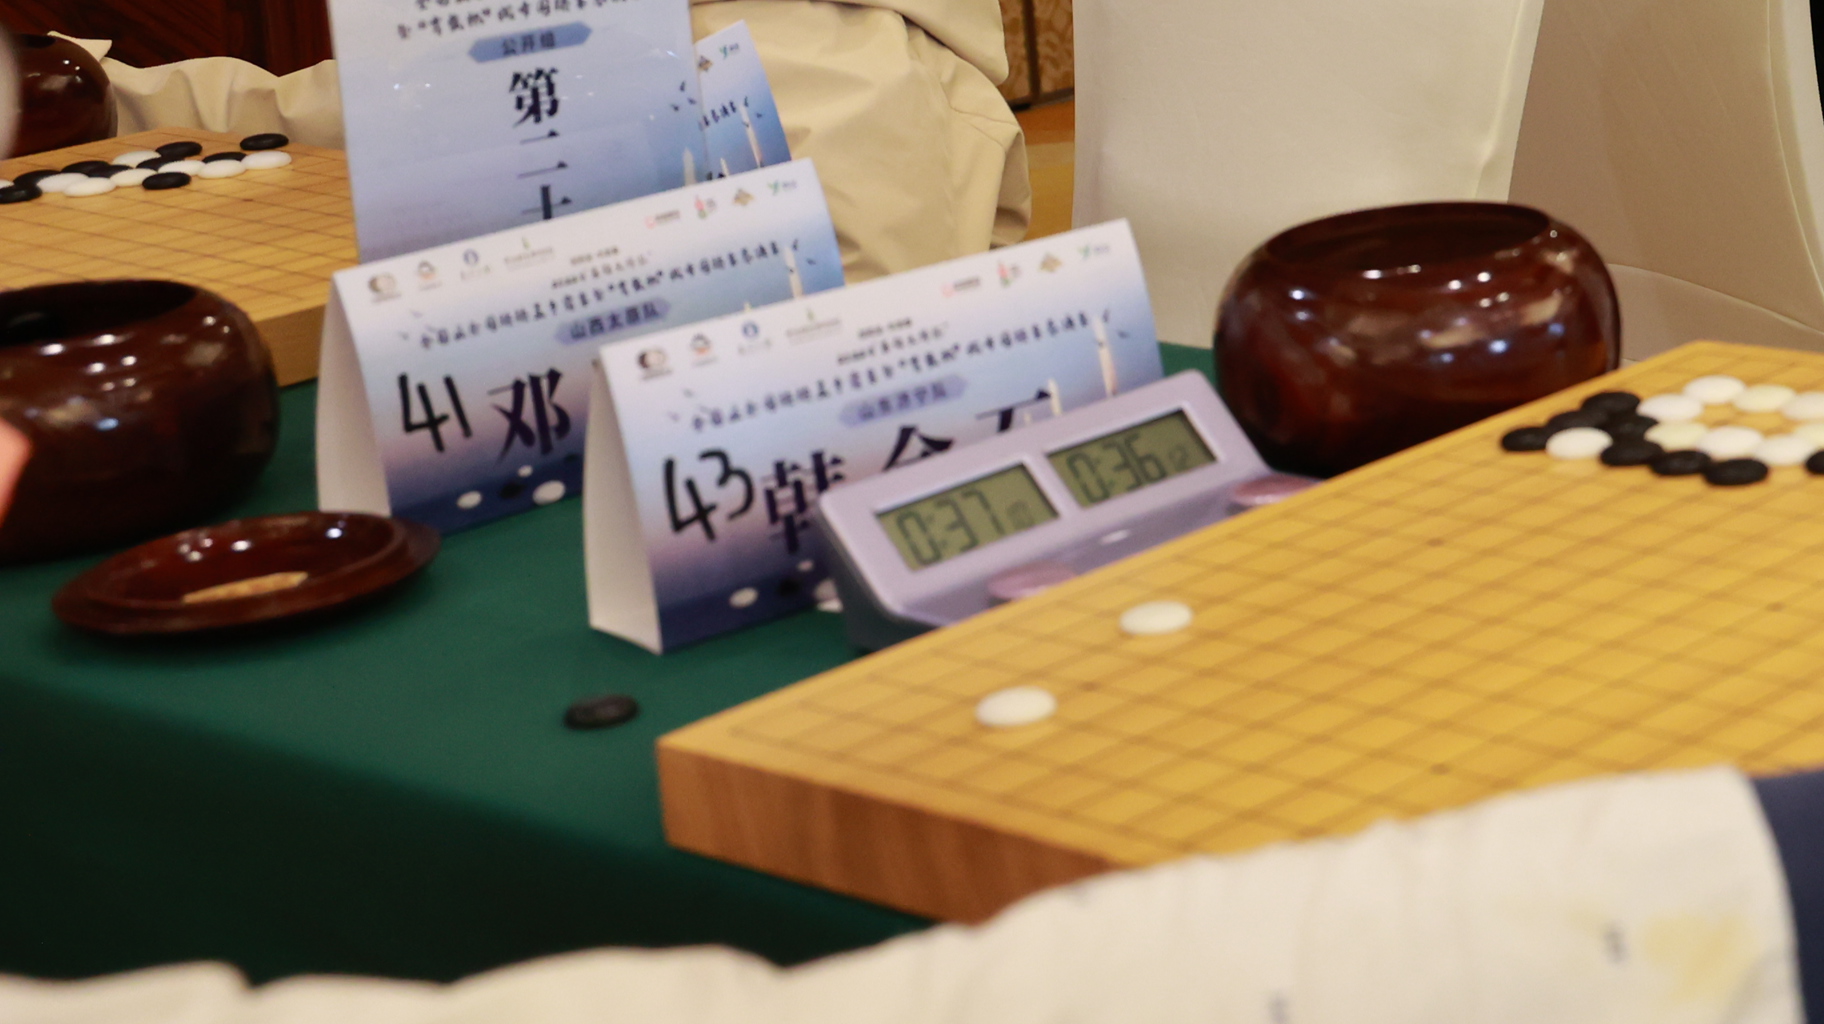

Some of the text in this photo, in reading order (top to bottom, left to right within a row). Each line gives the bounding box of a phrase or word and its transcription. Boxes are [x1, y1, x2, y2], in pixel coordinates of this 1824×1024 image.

[501, 30, 557, 57] 公开组
[569, 300, 662, 341] 山西太原队
[397, 372, 474, 453] 41
[487, 366, 573, 460] 邓
[661, 449, 755, 542] 43
[1066, 433, 1167, 504] 0:36
[896, 488, 1005, 567] 0:37
